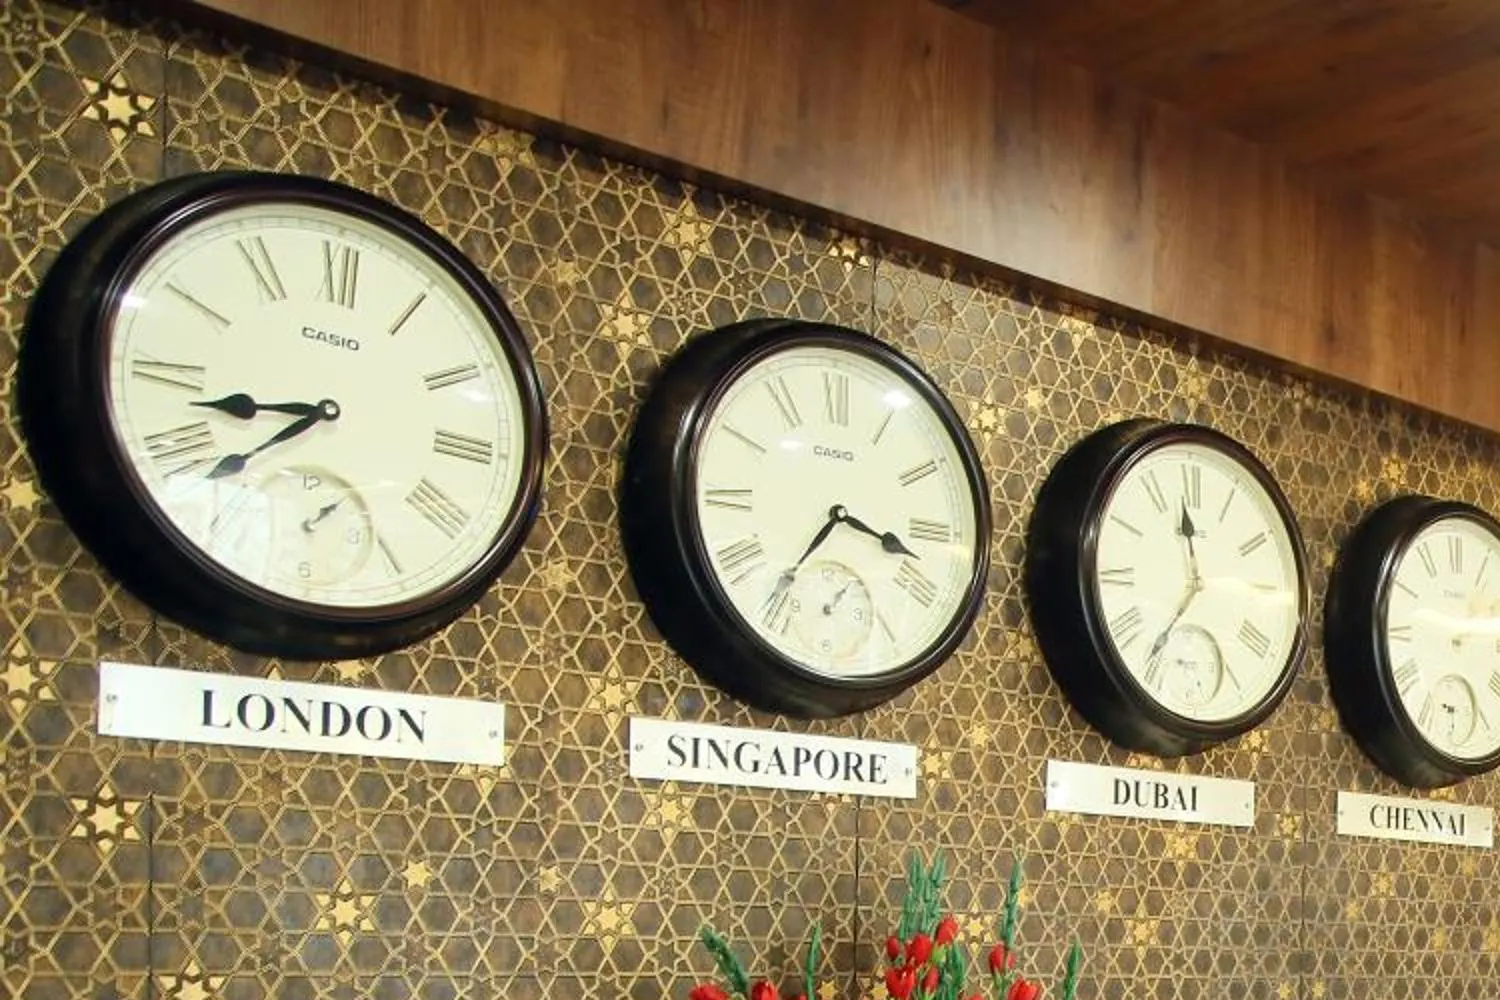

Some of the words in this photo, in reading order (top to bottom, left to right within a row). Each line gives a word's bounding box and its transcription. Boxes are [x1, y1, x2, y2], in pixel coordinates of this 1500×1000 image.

[315, 240, 359, 309] XII
[388, 292, 427, 336] I
[301, 325, 360, 351] CASIO
[423, 363, 480, 390] II
[821, 370, 848, 426] XII
[433, 430, 493, 465] III
[813, 445, 853, 462] CASIO
[899, 460, 938, 487] II
[909, 517, 950, 543] III
[200, 689, 427, 745] LONDON
[667, 733, 889, 785] SINGAPORE
[1113, 777, 1198, 812] DUBAI
[1369, 803, 1465, 837] CHENNAI
